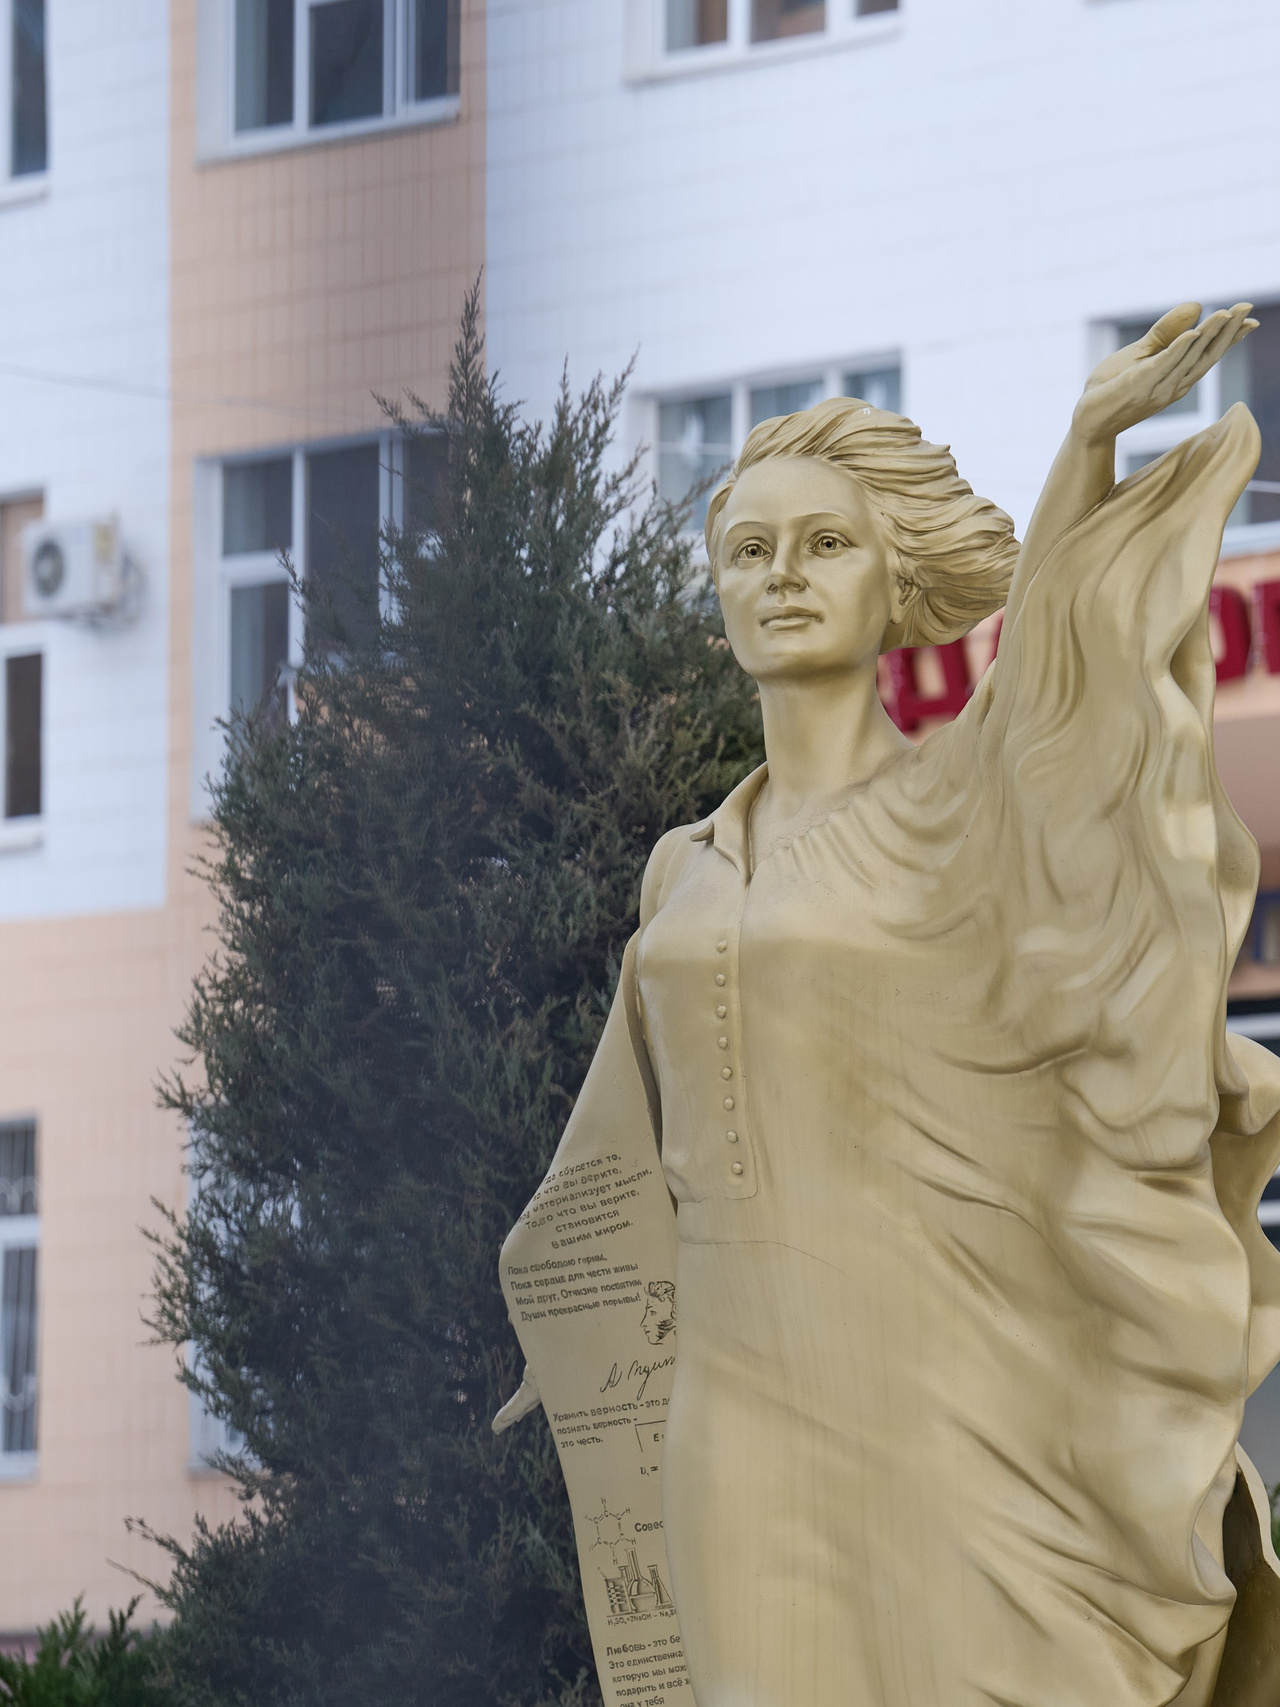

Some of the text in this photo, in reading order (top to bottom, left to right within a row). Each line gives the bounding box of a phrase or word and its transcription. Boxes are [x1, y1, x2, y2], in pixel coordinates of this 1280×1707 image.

[559, 1159, 603, 1178] сбудется
[533, 1183, 611, 1213] материализует
[544, 1184, 560, 1195] что
[557, 1207, 577, 1218] что
[580, 1201, 597, 1212] вы
[556, 1209, 620, 1233] становится
[508, 1266, 529, 1276] Пока
[530, 1259, 576, 1273] свободою
[511, 1263, 639, 1291] Пока сердца для чести живы
[516, 1294, 535, 1306] Мой
[561, 1286, 599, 1299] Отчизне
[601, 1279, 642, 1293] посвятим
[521, 1292, 641, 1322] Души прекрасные порывы!
[553, 1411, 588, 1423] Хранить
[590, 1402, 638, 1417] верность
[556, 1423, 591, 1436] познать
[593, 1417, 632, 1430] верность
[560, 1440, 575, 1449] это
[606, 1644, 646, 1656] Любовь
[653, 1639, 667, 1648] это
[609, 1650, 685, 1670] Это единственна
[612, 1671, 650, 1684] которую
[652, 1668, 666, 1677] мы
[616, 1684, 657, 1697] подарить
[666, 1677, 683, 1690] всё
[645, 1695, 665, 1707] тебя
